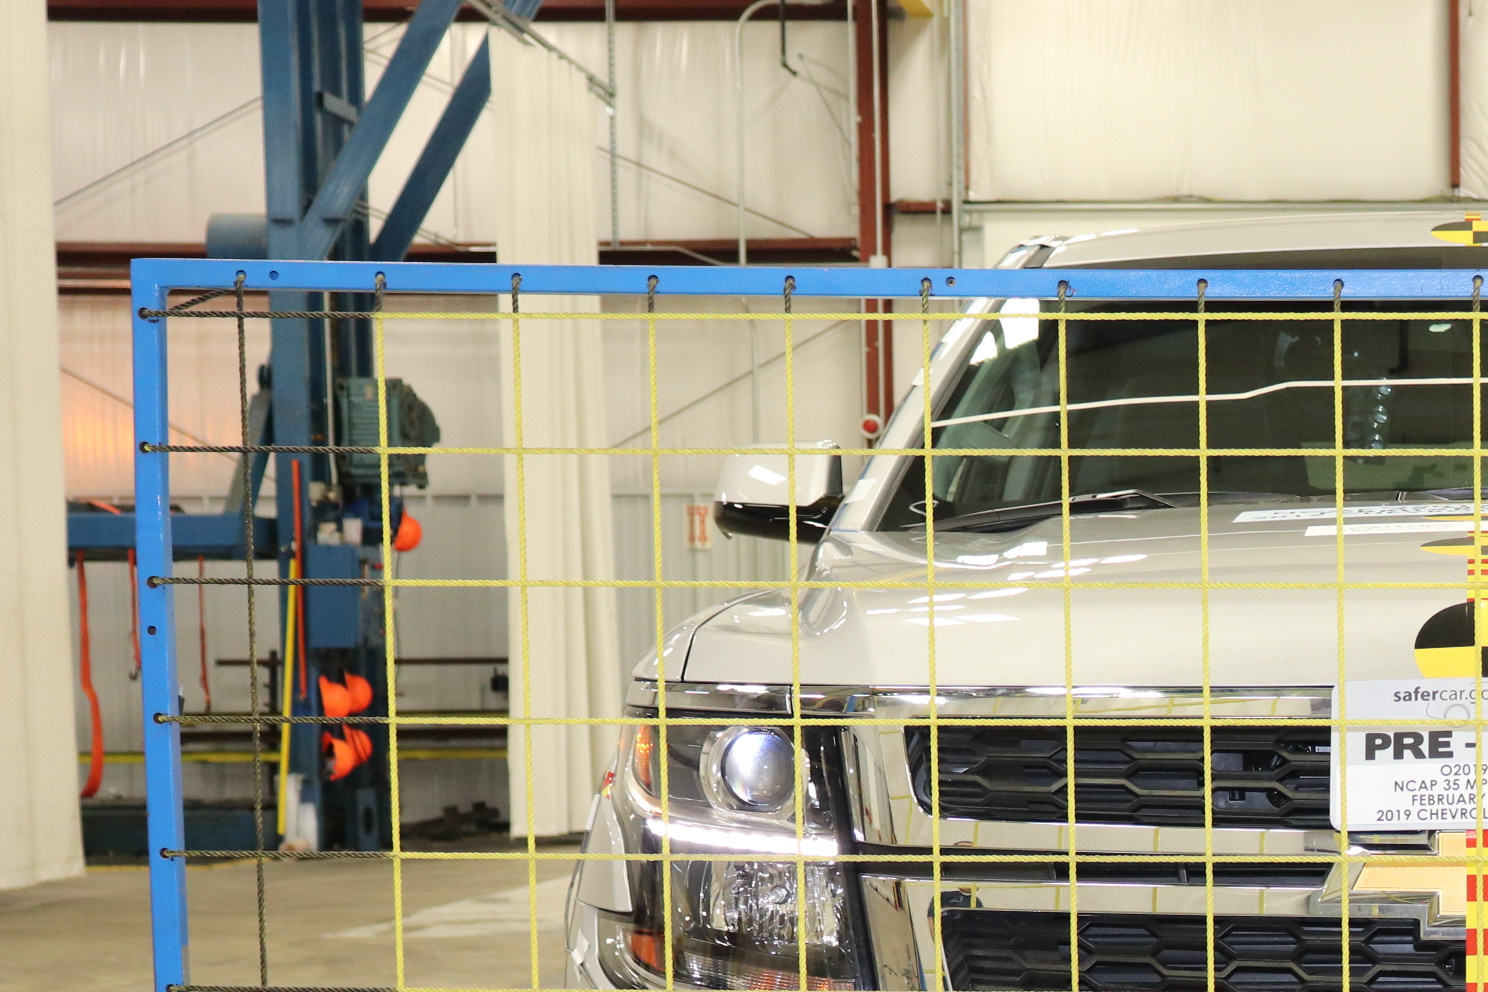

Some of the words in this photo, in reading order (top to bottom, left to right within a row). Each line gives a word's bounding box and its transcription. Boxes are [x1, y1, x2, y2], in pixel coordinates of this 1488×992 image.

[1365, 730, 1454, 761] PRE
[1394, 780, 1438, 792] NCAP
[1443, 779, 1460, 791] 35
[1376, 809, 1412, 822] 2019
